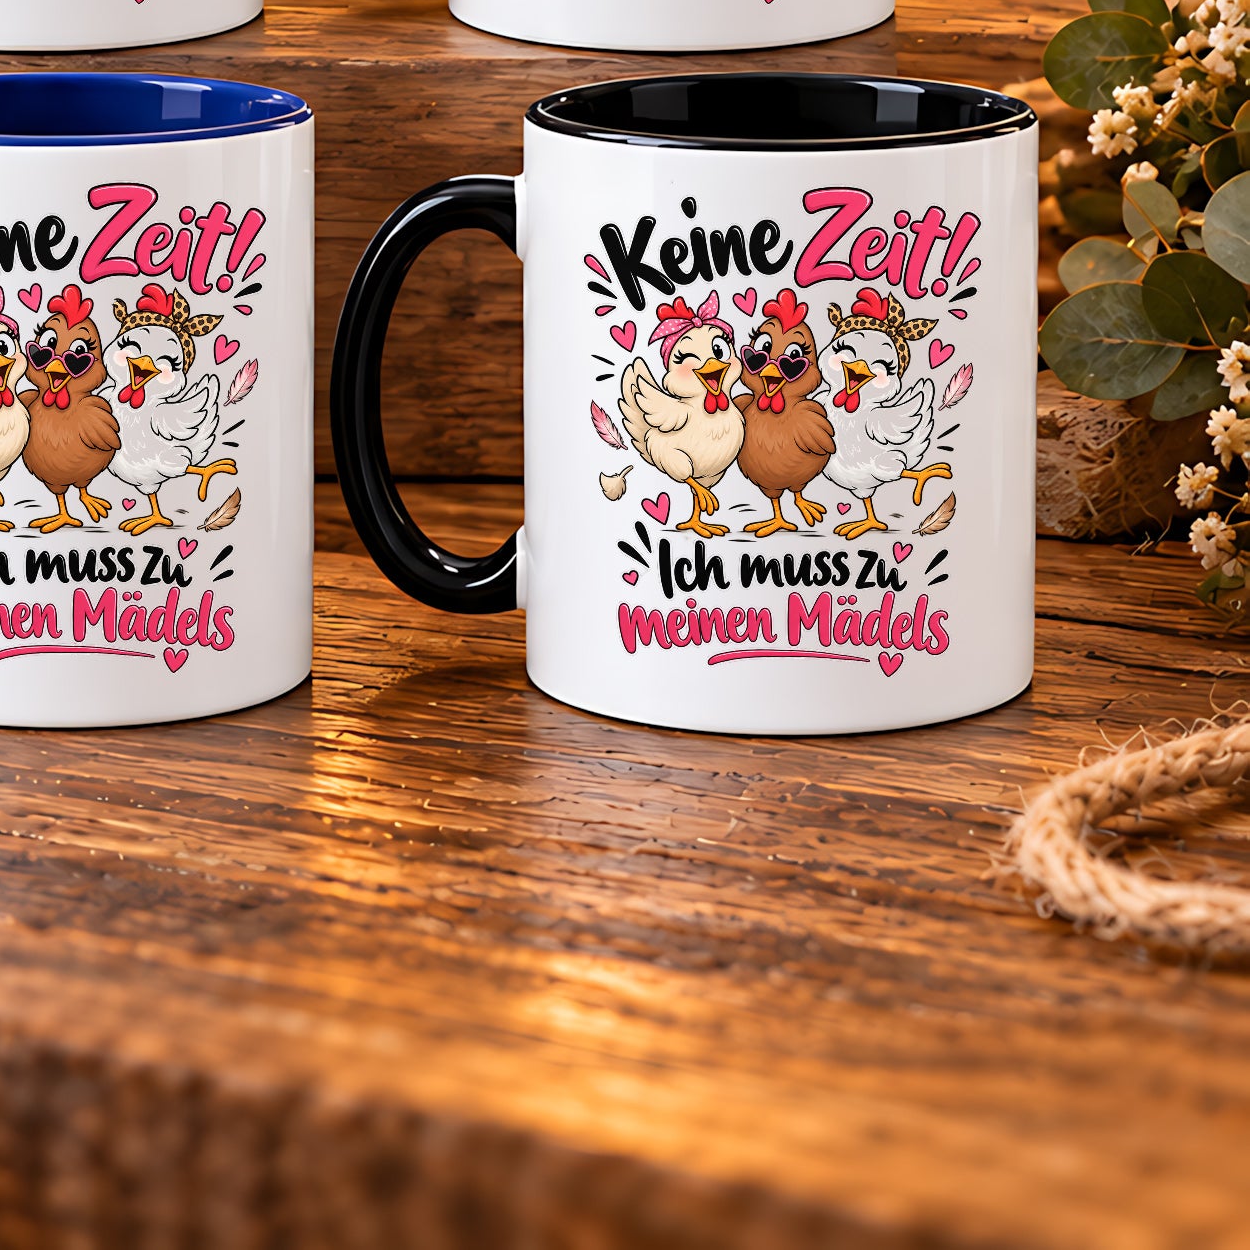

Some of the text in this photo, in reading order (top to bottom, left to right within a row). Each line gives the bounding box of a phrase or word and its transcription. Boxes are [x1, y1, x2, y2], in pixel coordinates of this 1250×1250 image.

[78, 182, 265, 295] Zeit!
[599, 187, 980, 311] Keine Zeit!
[26, 547, 136, 585] muss
[657, 539, 729, 599] Ich
[741, 551, 851, 590] muss
[73, 588, 234, 651] Mädels
[618, 592, 949, 655] meinen Mädels
